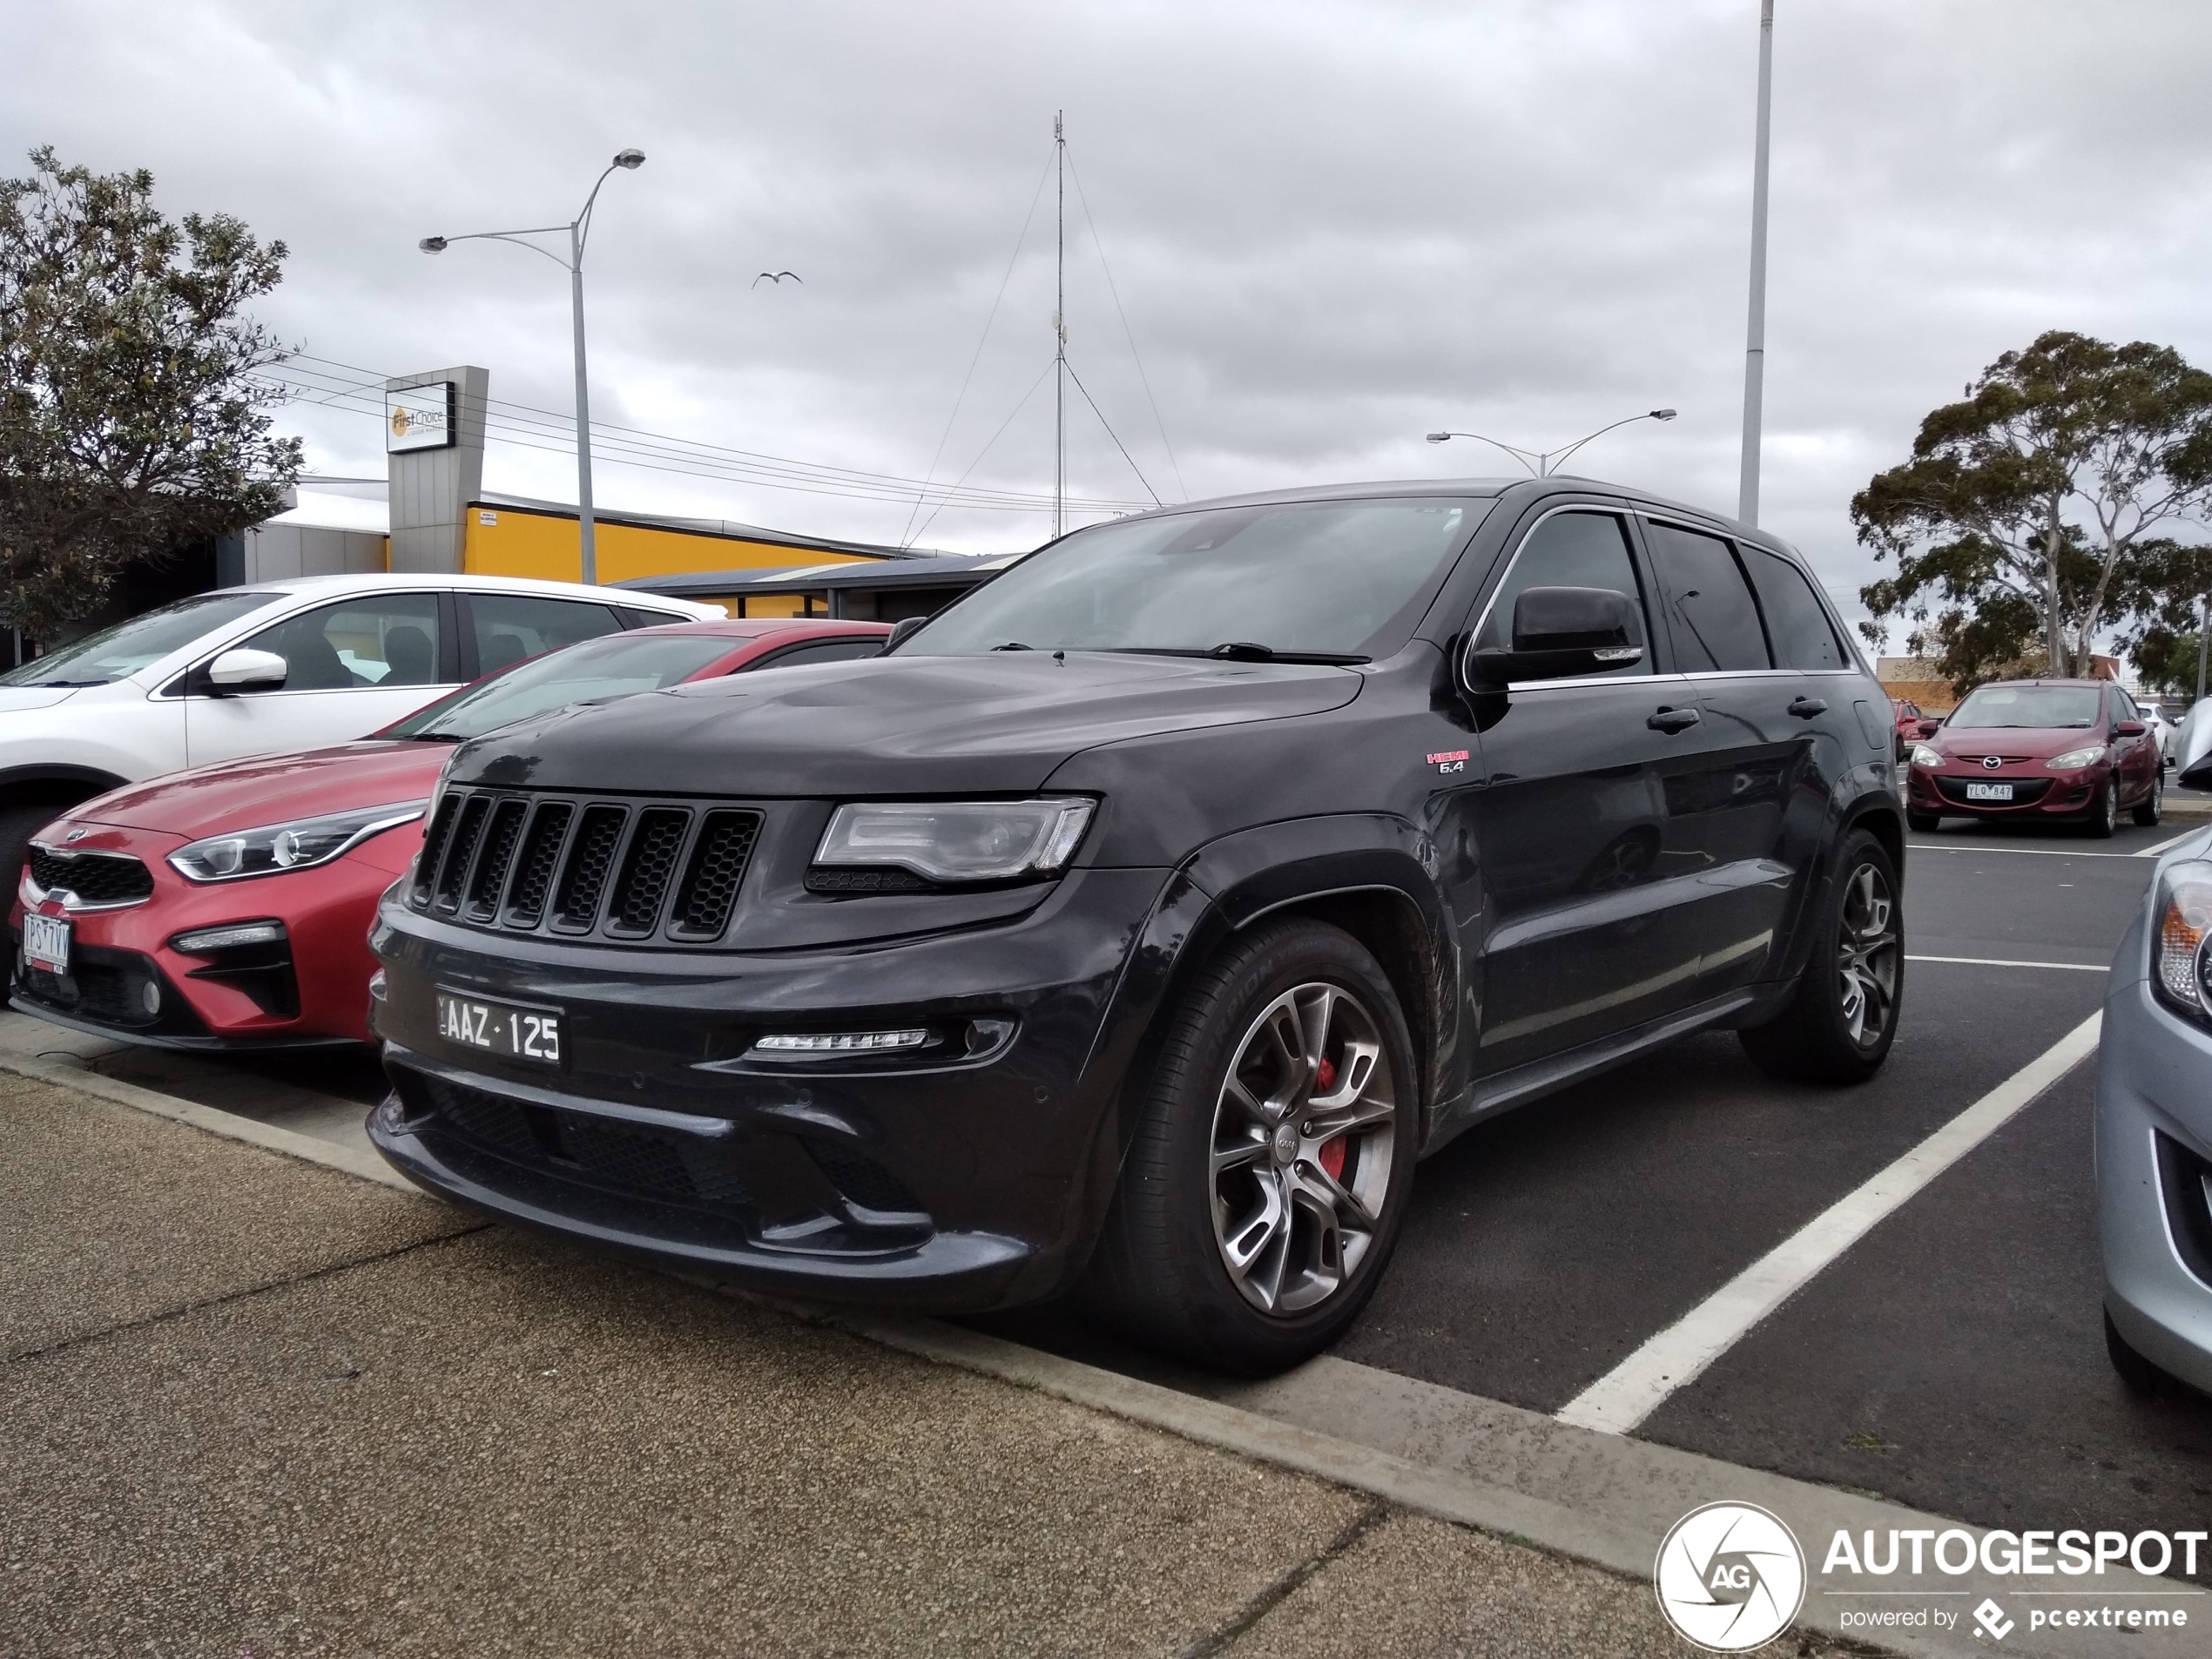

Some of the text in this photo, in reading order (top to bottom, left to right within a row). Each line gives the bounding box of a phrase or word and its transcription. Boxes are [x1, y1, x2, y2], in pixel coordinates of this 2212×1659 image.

[394, 409, 442, 428] First Choice
[1426, 750, 1469, 764] HEMI
[1440, 761, 1464, 774] 6.4
